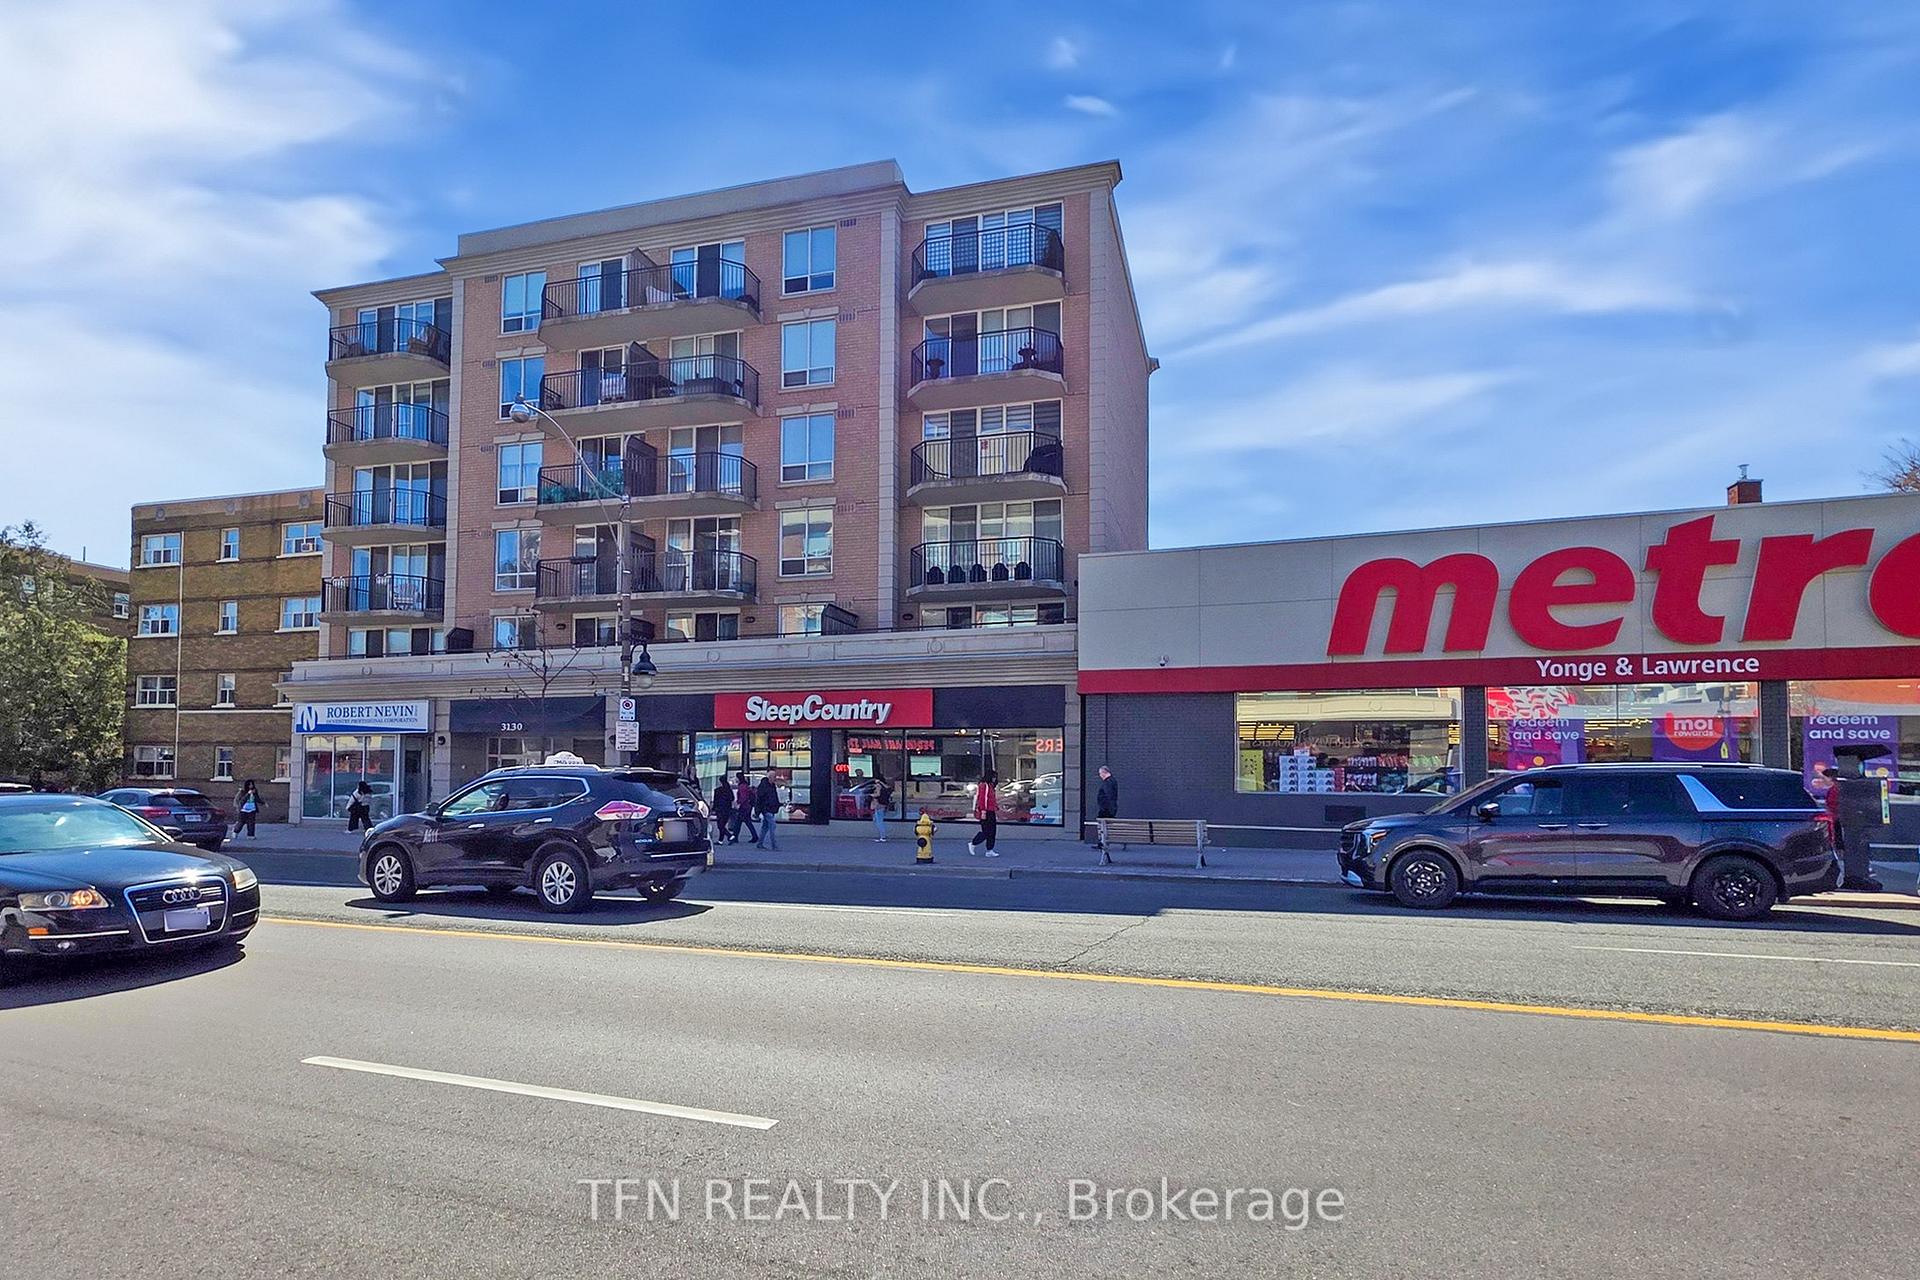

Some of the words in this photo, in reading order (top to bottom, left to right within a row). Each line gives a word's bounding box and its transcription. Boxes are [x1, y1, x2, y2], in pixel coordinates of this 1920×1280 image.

[1536, 659, 1606, 682] Yonge
[1615, 657, 1633, 676] &
[1642, 657, 1760, 675] Lawrence
[326, 706, 372, 718] ROBERT
[374, 705, 414, 717] NEVIN
[745, 693, 892, 725] SleepCountry
[1809, 715, 1878, 725] redeem
[501, 723, 523, 731] 3130
[1513, 730, 1541, 740] and
[1545, 731, 1579, 740] save
[1809, 728, 1844, 739] and
[1847, 729, 1890, 739] save
